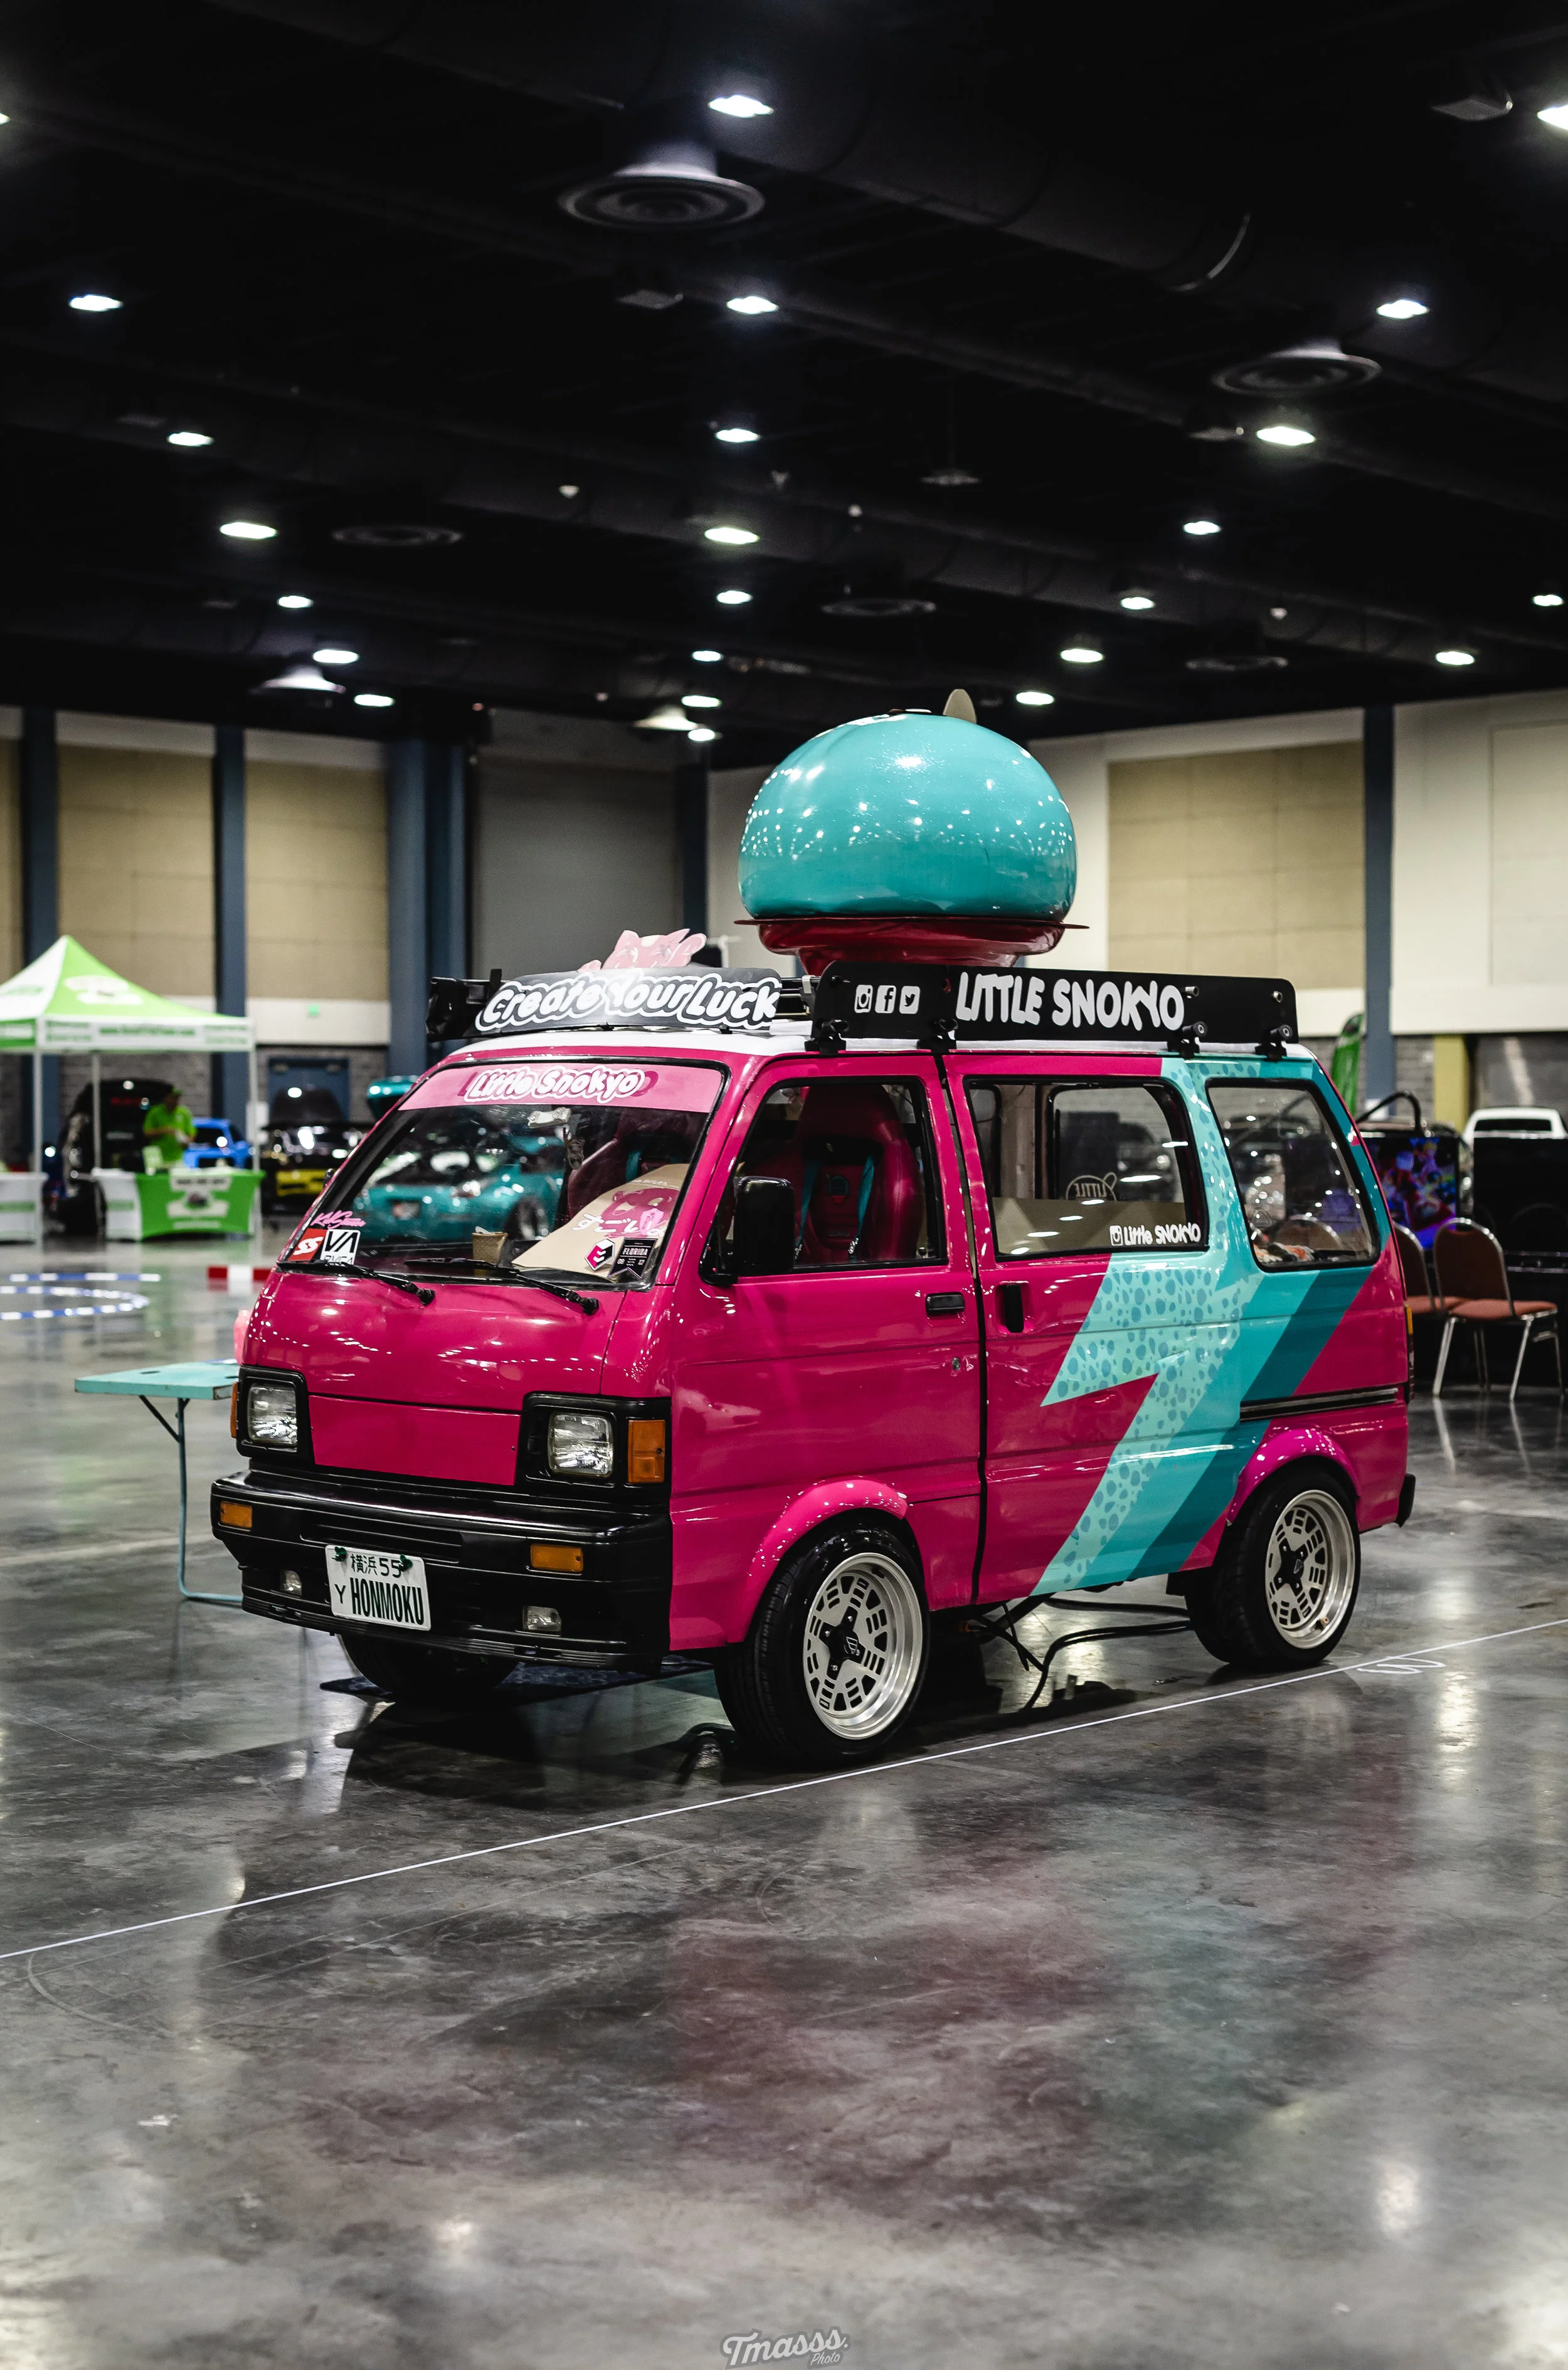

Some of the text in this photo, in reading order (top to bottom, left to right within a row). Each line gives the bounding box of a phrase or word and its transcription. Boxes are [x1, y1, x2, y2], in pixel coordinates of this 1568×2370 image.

[482, 976, 779, 1024] Create Your Luck
[955, 971, 1185, 1031] LITTLE SNOKYO
[469, 1070, 640, 1099] Little Snokyo
[622, 1247, 649, 1256] FLORIDA
[1124, 1222, 1201, 1246] Little SNOKYO
[334, 1577, 425, 1626] Y HONMOKU
